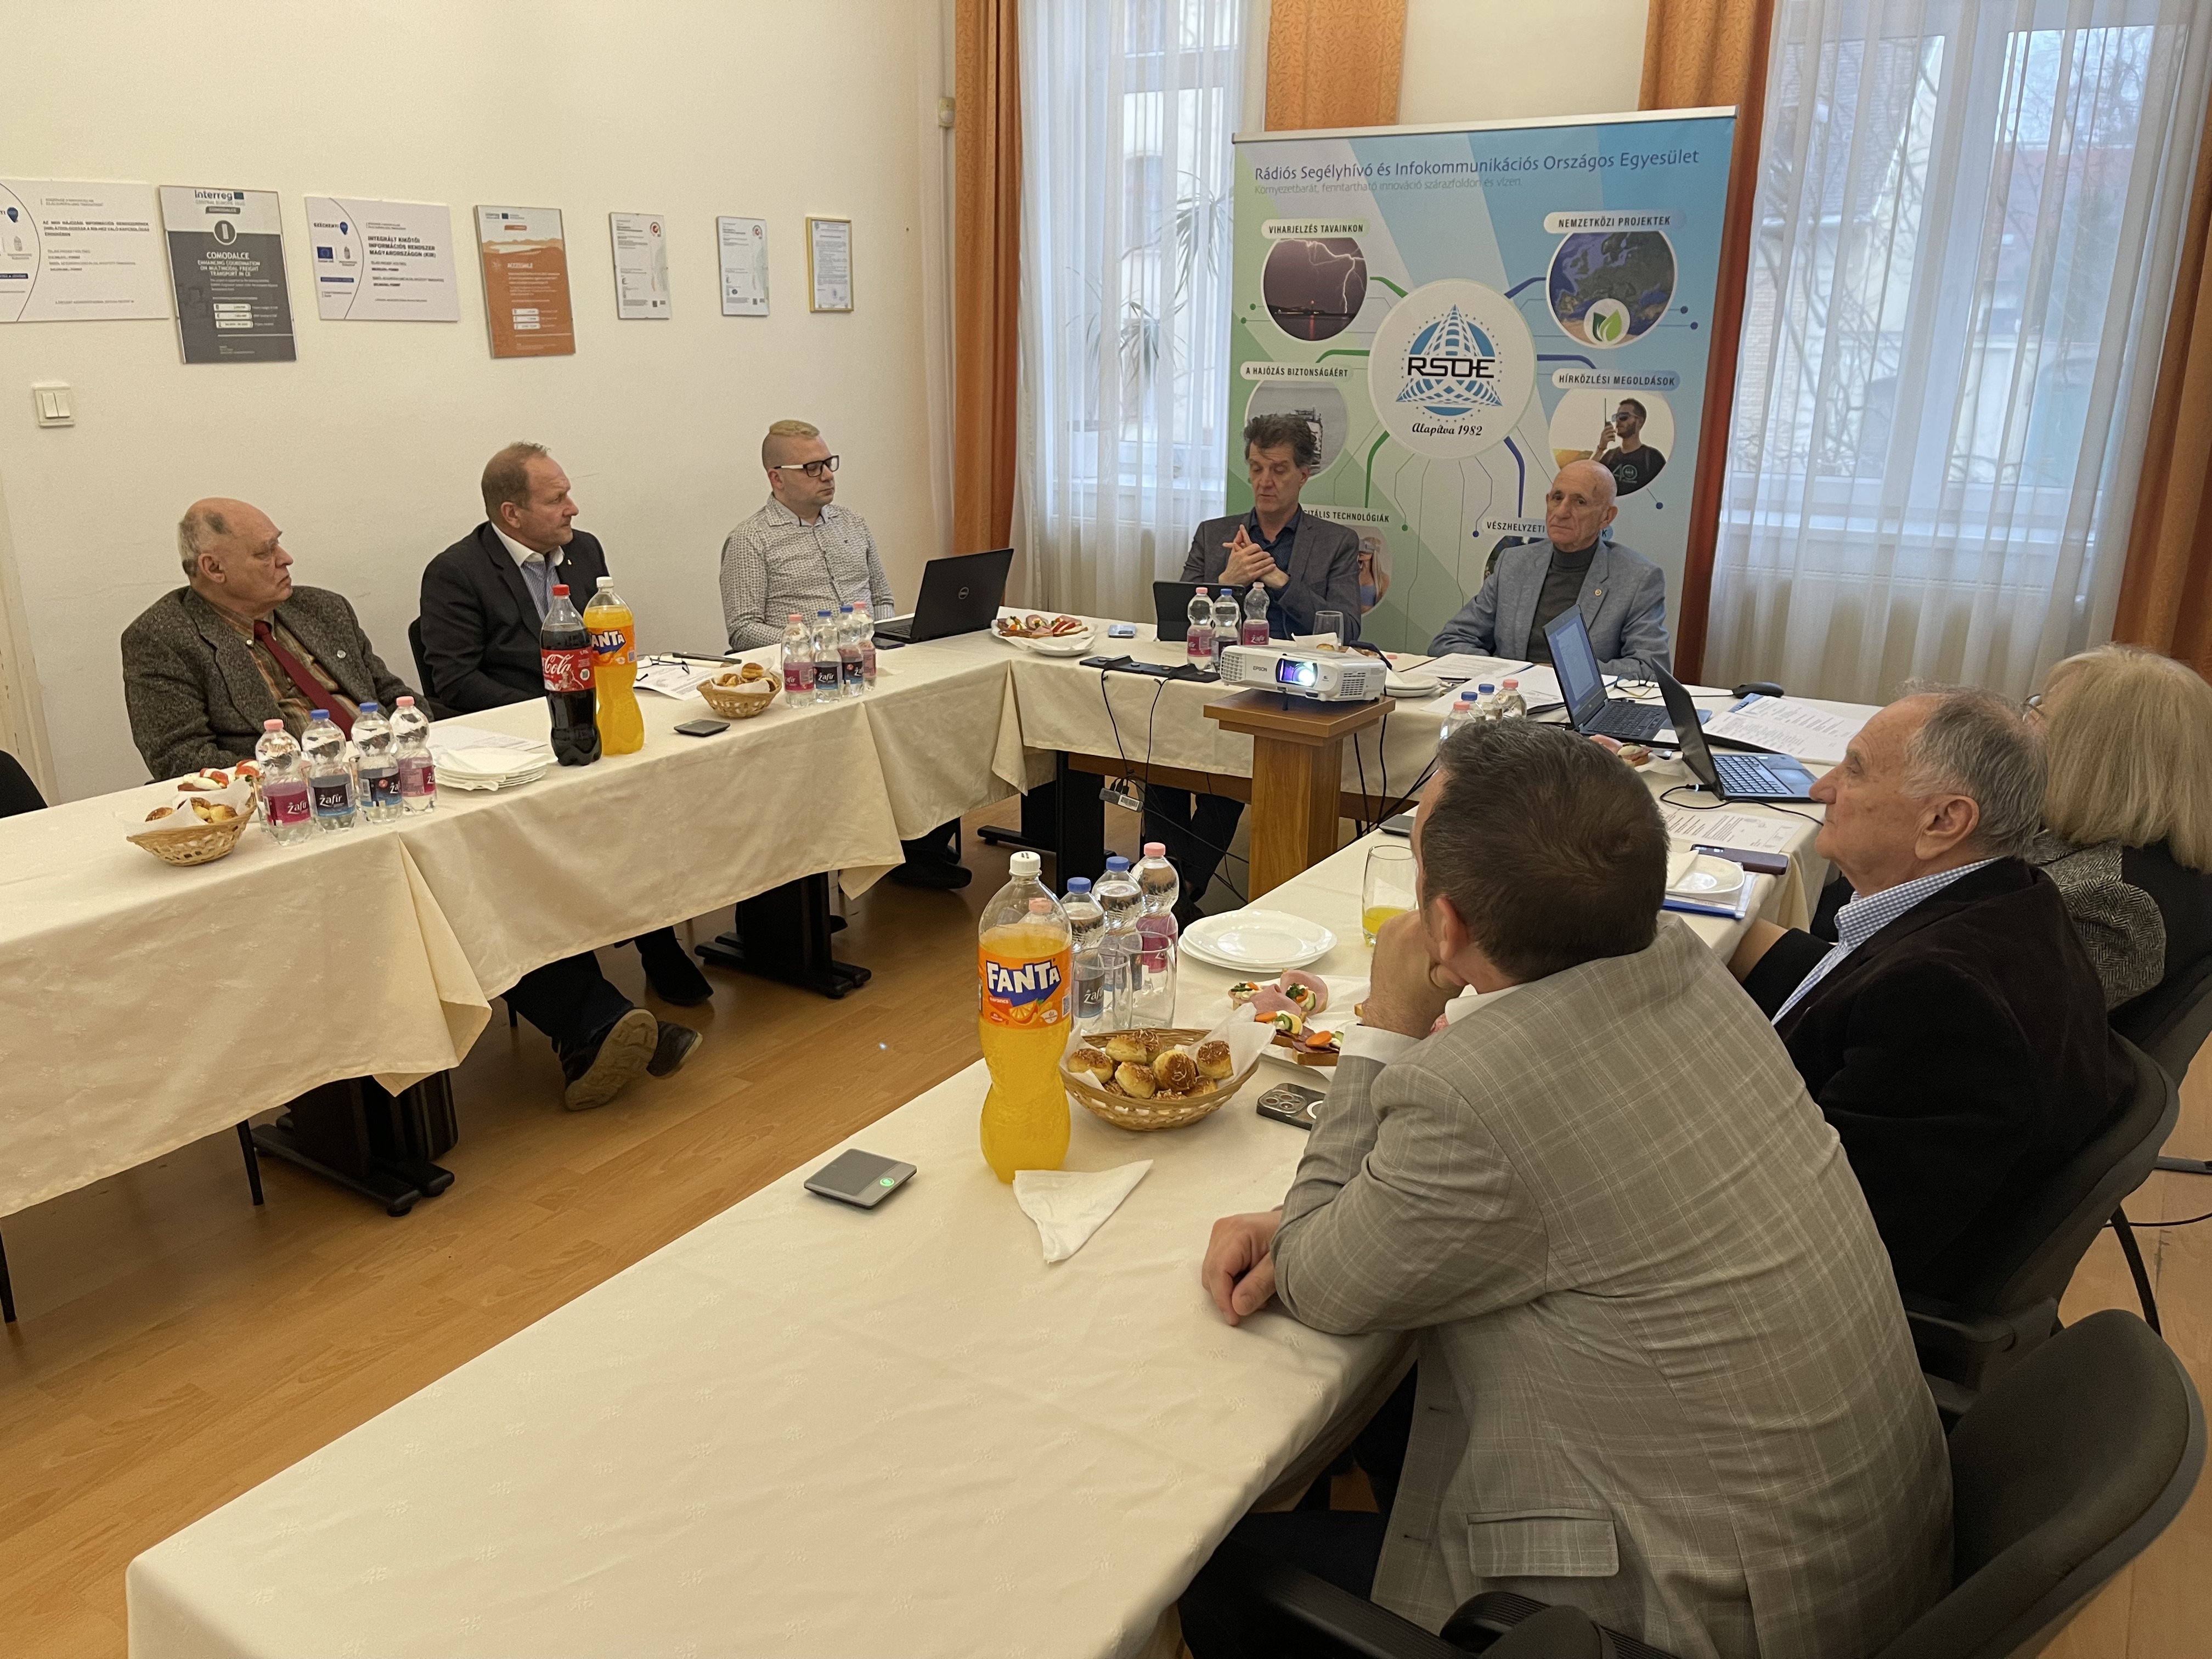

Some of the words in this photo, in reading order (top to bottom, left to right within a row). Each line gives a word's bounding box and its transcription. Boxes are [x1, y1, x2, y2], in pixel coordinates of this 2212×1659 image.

[1255, 166, 1296, 180] Rádiós
[1301, 163, 1373, 182] Segélyhívó
[1377, 162, 1391, 176] és
[1396, 156, 1539, 175] Infokommunikációs
[1543, 154, 1615, 172] Országos
[1620, 149, 1700, 171] Egyesület
[1484, 178, 1494, 188] és
[194, 189, 233, 201] Interreg
[1558, 217, 1615, 228] NEMZETKÖZI
[1618, 216, 1671, 226] PROJEKTEK
[1268, 223, 1318, 234] VIHARJELZÉS
[1321, 224, 1363, 233] TAVAINKON
[206, 251, 250, 260] COMODALCE
[1246, 366, 1251, 375] A
[1252, 365, 1285, 376] HAJÓZÁS
[1287, 366, 1348, 377] BIZTONSÁGÁÉRT
[1407, 357, 1496, 379] RSOE
[1559, 373, 1610, 385] HÍRKÖZLÉSI
[1613, 374, 1675, 386] MEGOLDÁSOK
[1412, 422, 1455, 436] Alapítva
[1458, 425, 1483, 436] 1982
[1304, 509, 1330, 518] ITÁLIS
[1333, 511, 1390, 522] TECHNOLÓGIÁK
[1487, 521, 1545, 533] VÉSZHELYZETI
[591, 631, 625, 648] ANTA
[987, 962, 1060, 993] FANTA
